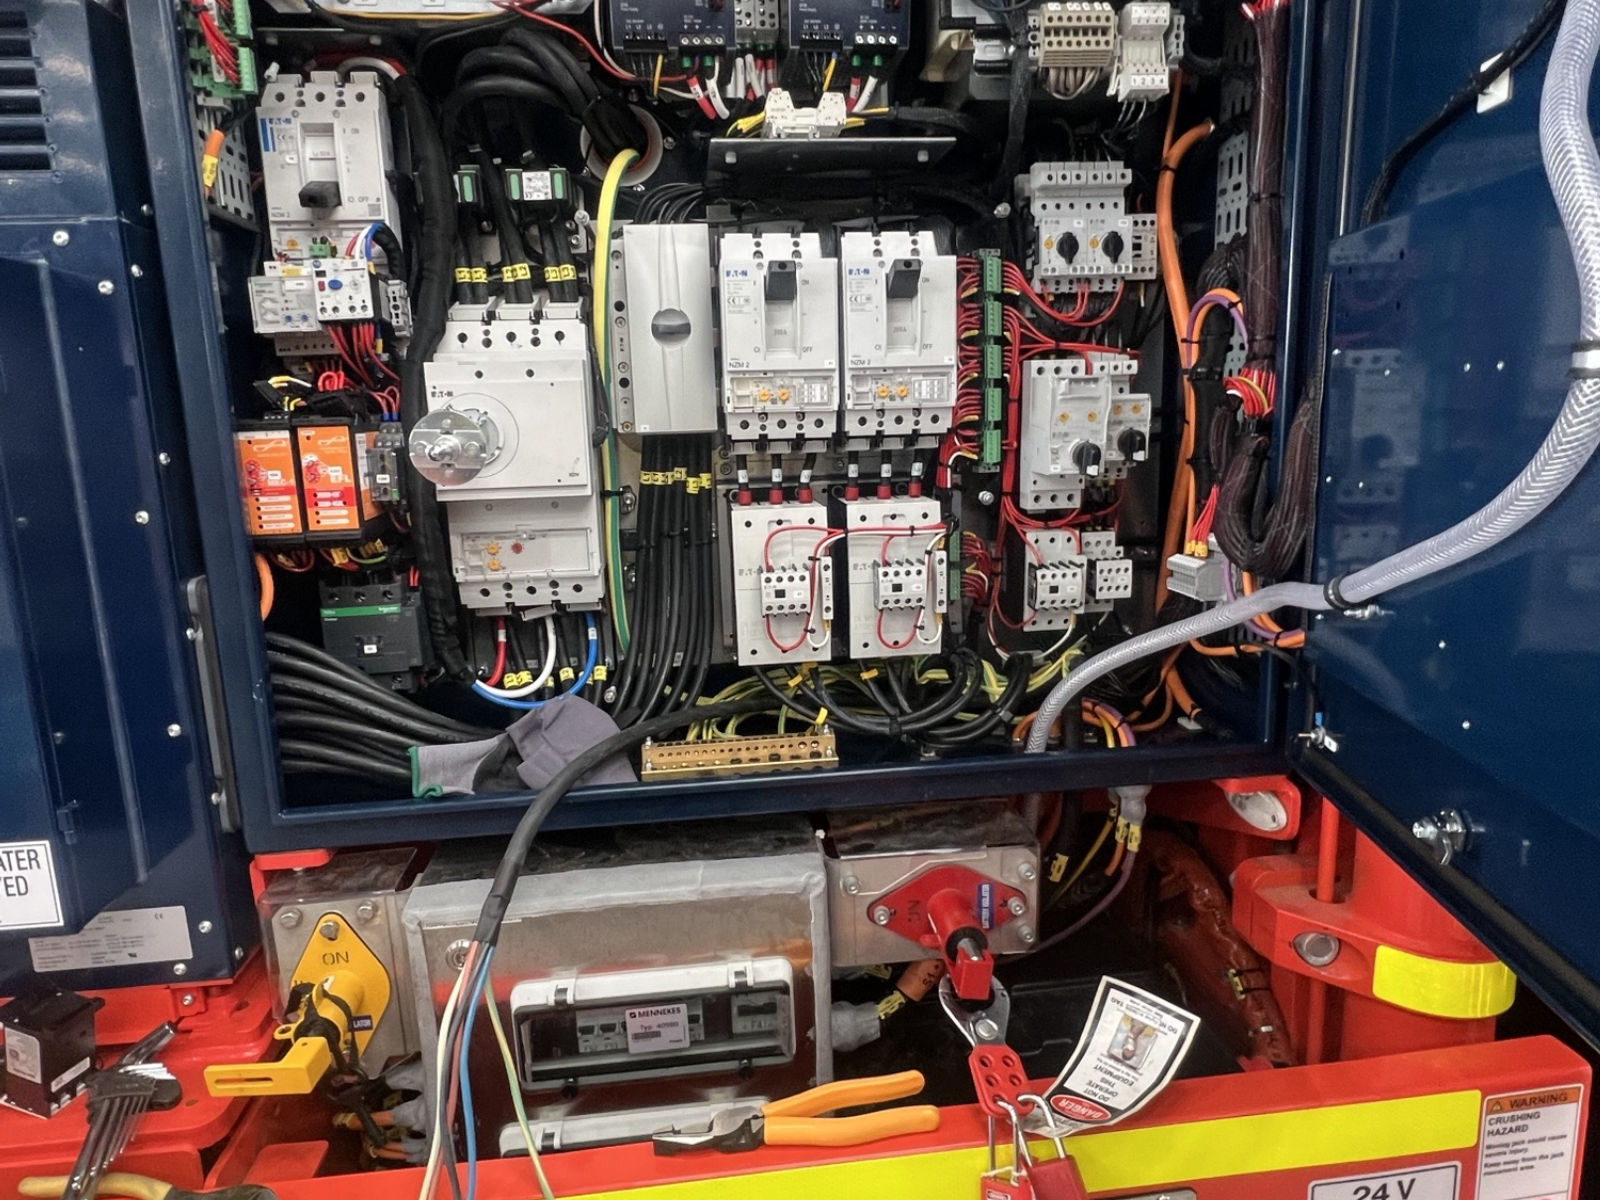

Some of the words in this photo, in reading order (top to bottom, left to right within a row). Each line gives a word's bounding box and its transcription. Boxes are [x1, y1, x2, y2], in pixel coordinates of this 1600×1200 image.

[0, 875, 28, 897] ED
[322, 951, 350, 966] ON
[637, 1007, 682, 1019] MENNEKES
[1093, 1064, 1135, 1086] EQUIPMENT
[1086, 1079, 1119, 1098] OPERATE
[1099, 1094, 1111, 1103] DO
[1509, 1092, 1568, 1109] WARNING
[1058, 1097, 1105, 1119] DANGER
[1488, 1111, 1541, 1126] CRUSHING
[1486, 1124, 1529, 1137] HAZARD
[1353, 1183, 1390, 1200] 24
[1397, 1178, 1417, 1200] V
